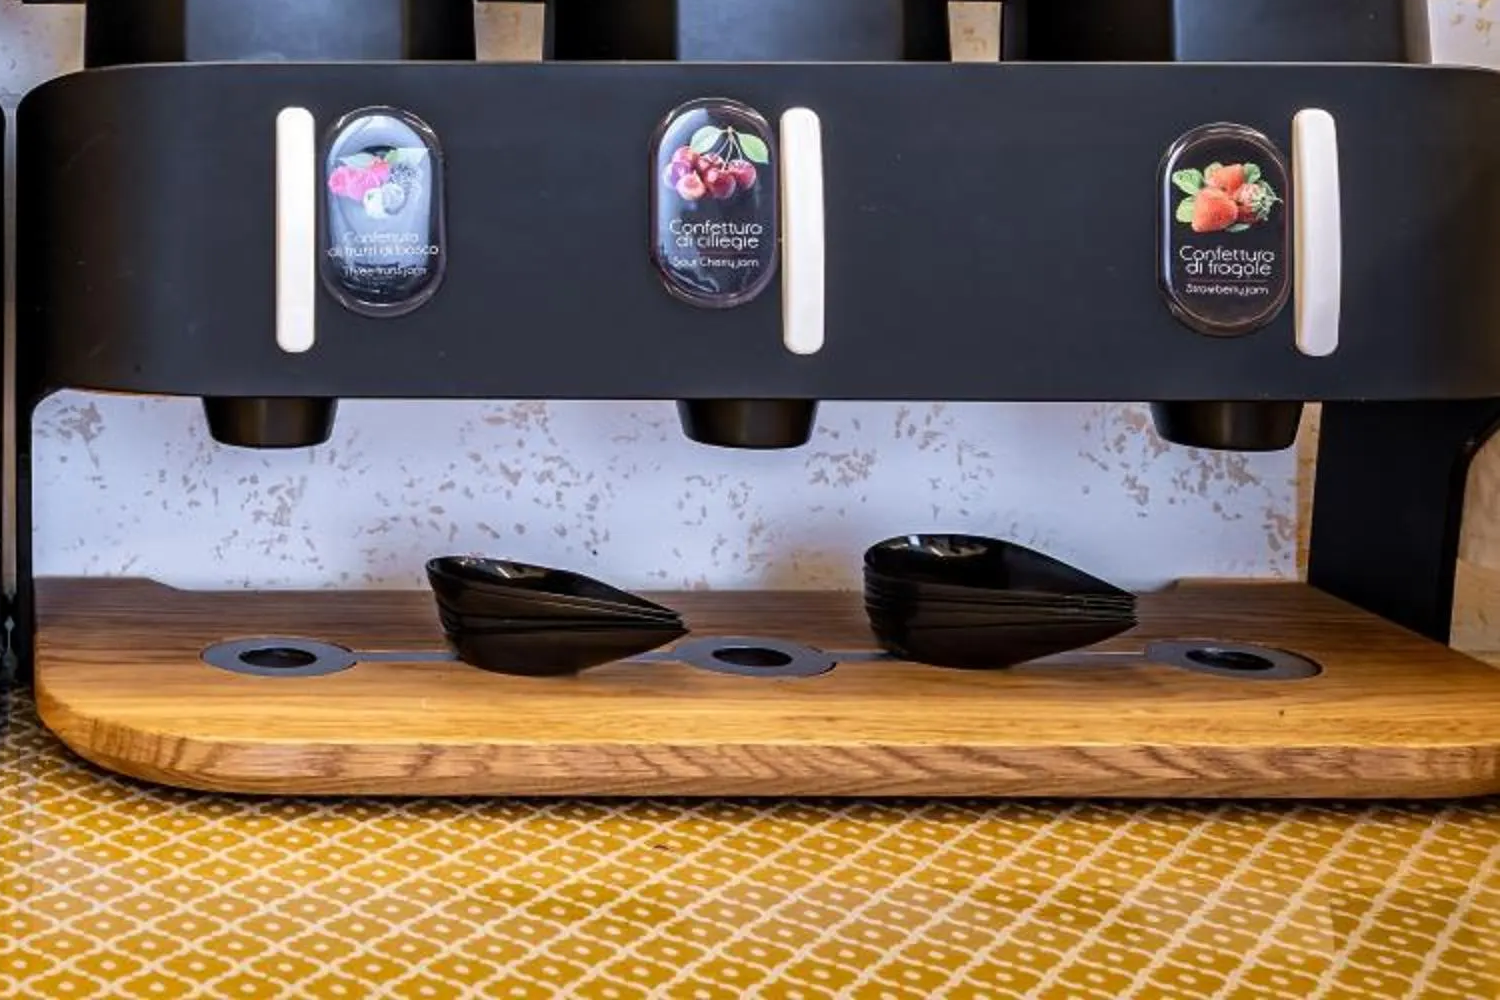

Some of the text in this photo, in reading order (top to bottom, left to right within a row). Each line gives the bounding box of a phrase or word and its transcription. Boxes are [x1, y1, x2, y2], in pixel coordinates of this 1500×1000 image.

[669, 220, 763, 236] Confettura
[1180, 245, 1275, 262] Confettura
[1185, 259, 1272, 278] di fragole
